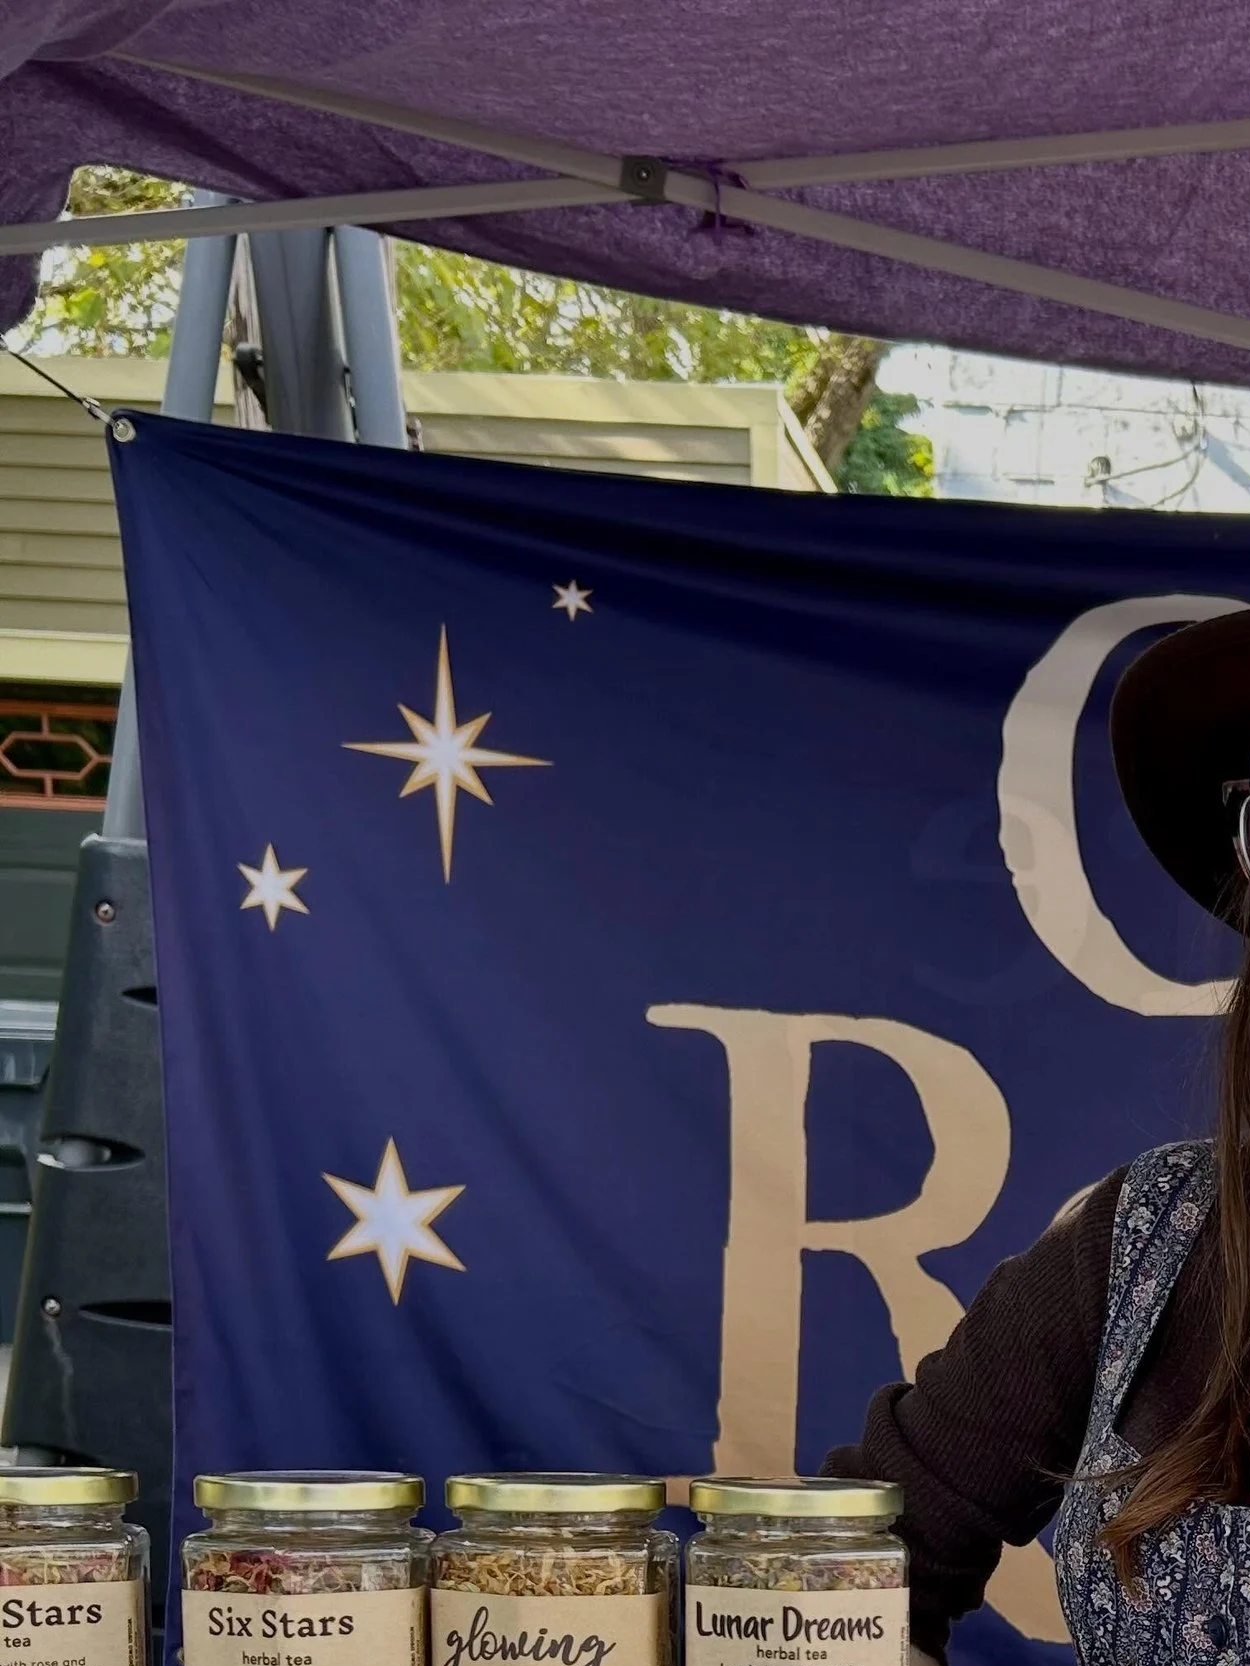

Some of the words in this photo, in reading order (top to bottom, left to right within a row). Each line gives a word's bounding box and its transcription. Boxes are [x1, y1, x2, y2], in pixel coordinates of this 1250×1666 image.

[3, 1599, 103, 1629] Stars
[696, 1601, 773, 1641] Lunar
[783, 1606, 884, 1642] Dreams
[208, 1606, 253, 1637] Six
[261, 1609, 355, 1639] Stars
[4, 1636, 31, 1648] tea
[242, 1651, 281, 1666] herbal
[286, 1654, 313, 1666] tea
[757, 1646, 800, 1660] herbal
[806, 1649, 827, 1660] tea
[63, 1657, 86, 1666] and
